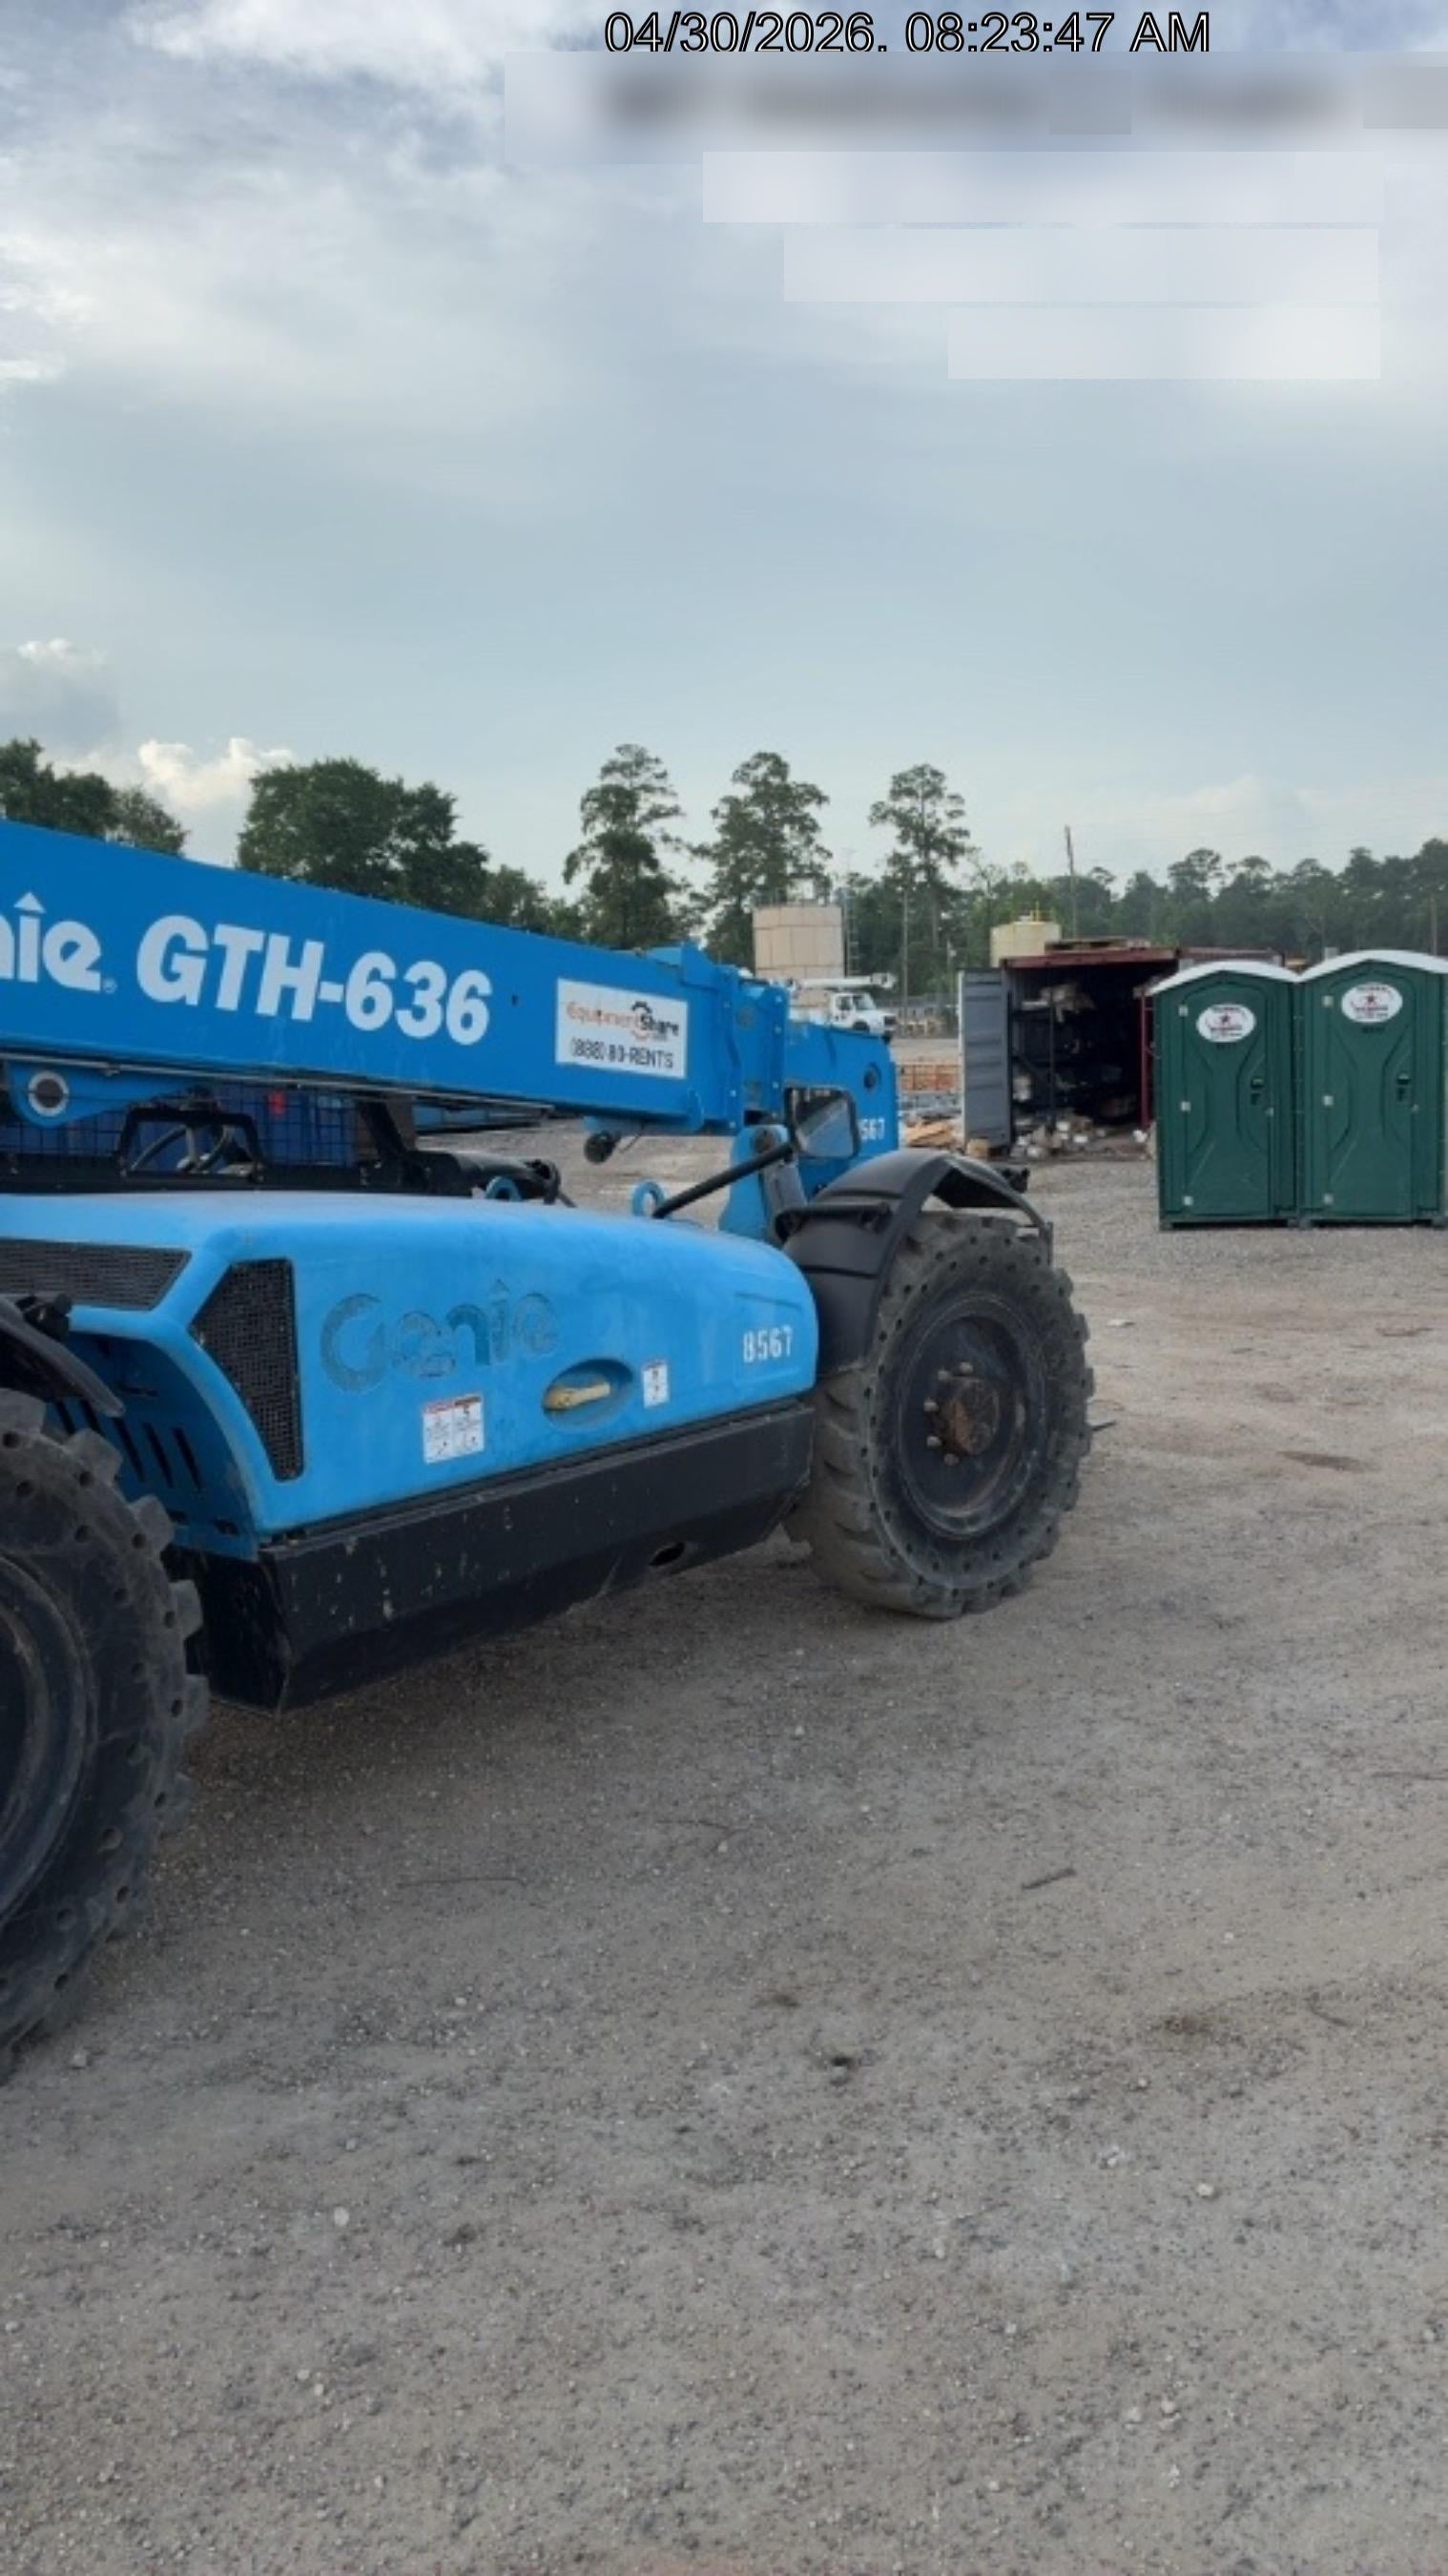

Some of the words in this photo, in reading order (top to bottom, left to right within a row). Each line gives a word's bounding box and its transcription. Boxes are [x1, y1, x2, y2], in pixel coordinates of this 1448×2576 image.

[136, 915, 491, 1046] GTH-636
[320, 1278, 558, 1393] Genie
[743, 1325, 793, 1363] 8567
